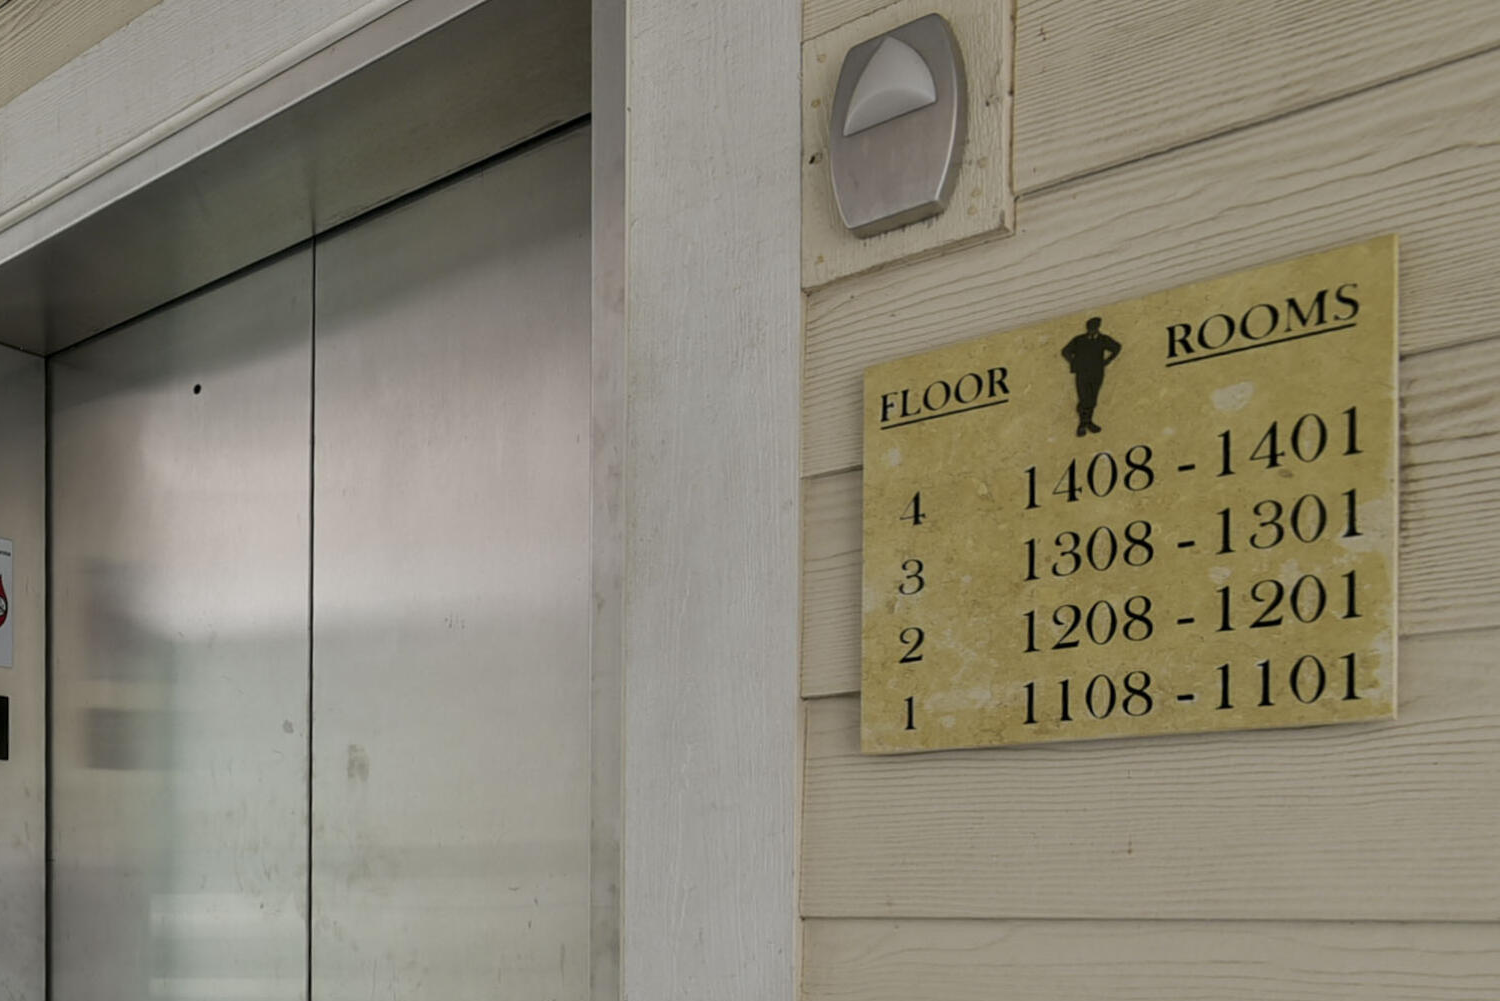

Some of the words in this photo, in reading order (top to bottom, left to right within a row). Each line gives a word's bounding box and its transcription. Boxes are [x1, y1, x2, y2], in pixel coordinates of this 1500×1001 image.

[880, 366, 1011, 423] FLOOR
[1165, 283, 1360, 360] ROOMS
[899, 490, 927, 527] 4
[1024, 444, 1155, 511] 1408
[1216, 405, 1364, 478] 1401
[897, 558, 926, 595] 3
[1023, 519, 1155, 583] 1308
[1215, 487, 1363, 556] 1301
[897, 626, 925, 665] 2
[1023, 595, 1154, 654] 1208
[1215, 569, 1363, 633] 1201
[903, 695, 917, 731] 1
[1022, 670, 1154, 726] 1108
[1215, 652, 1362, 711] 1101
